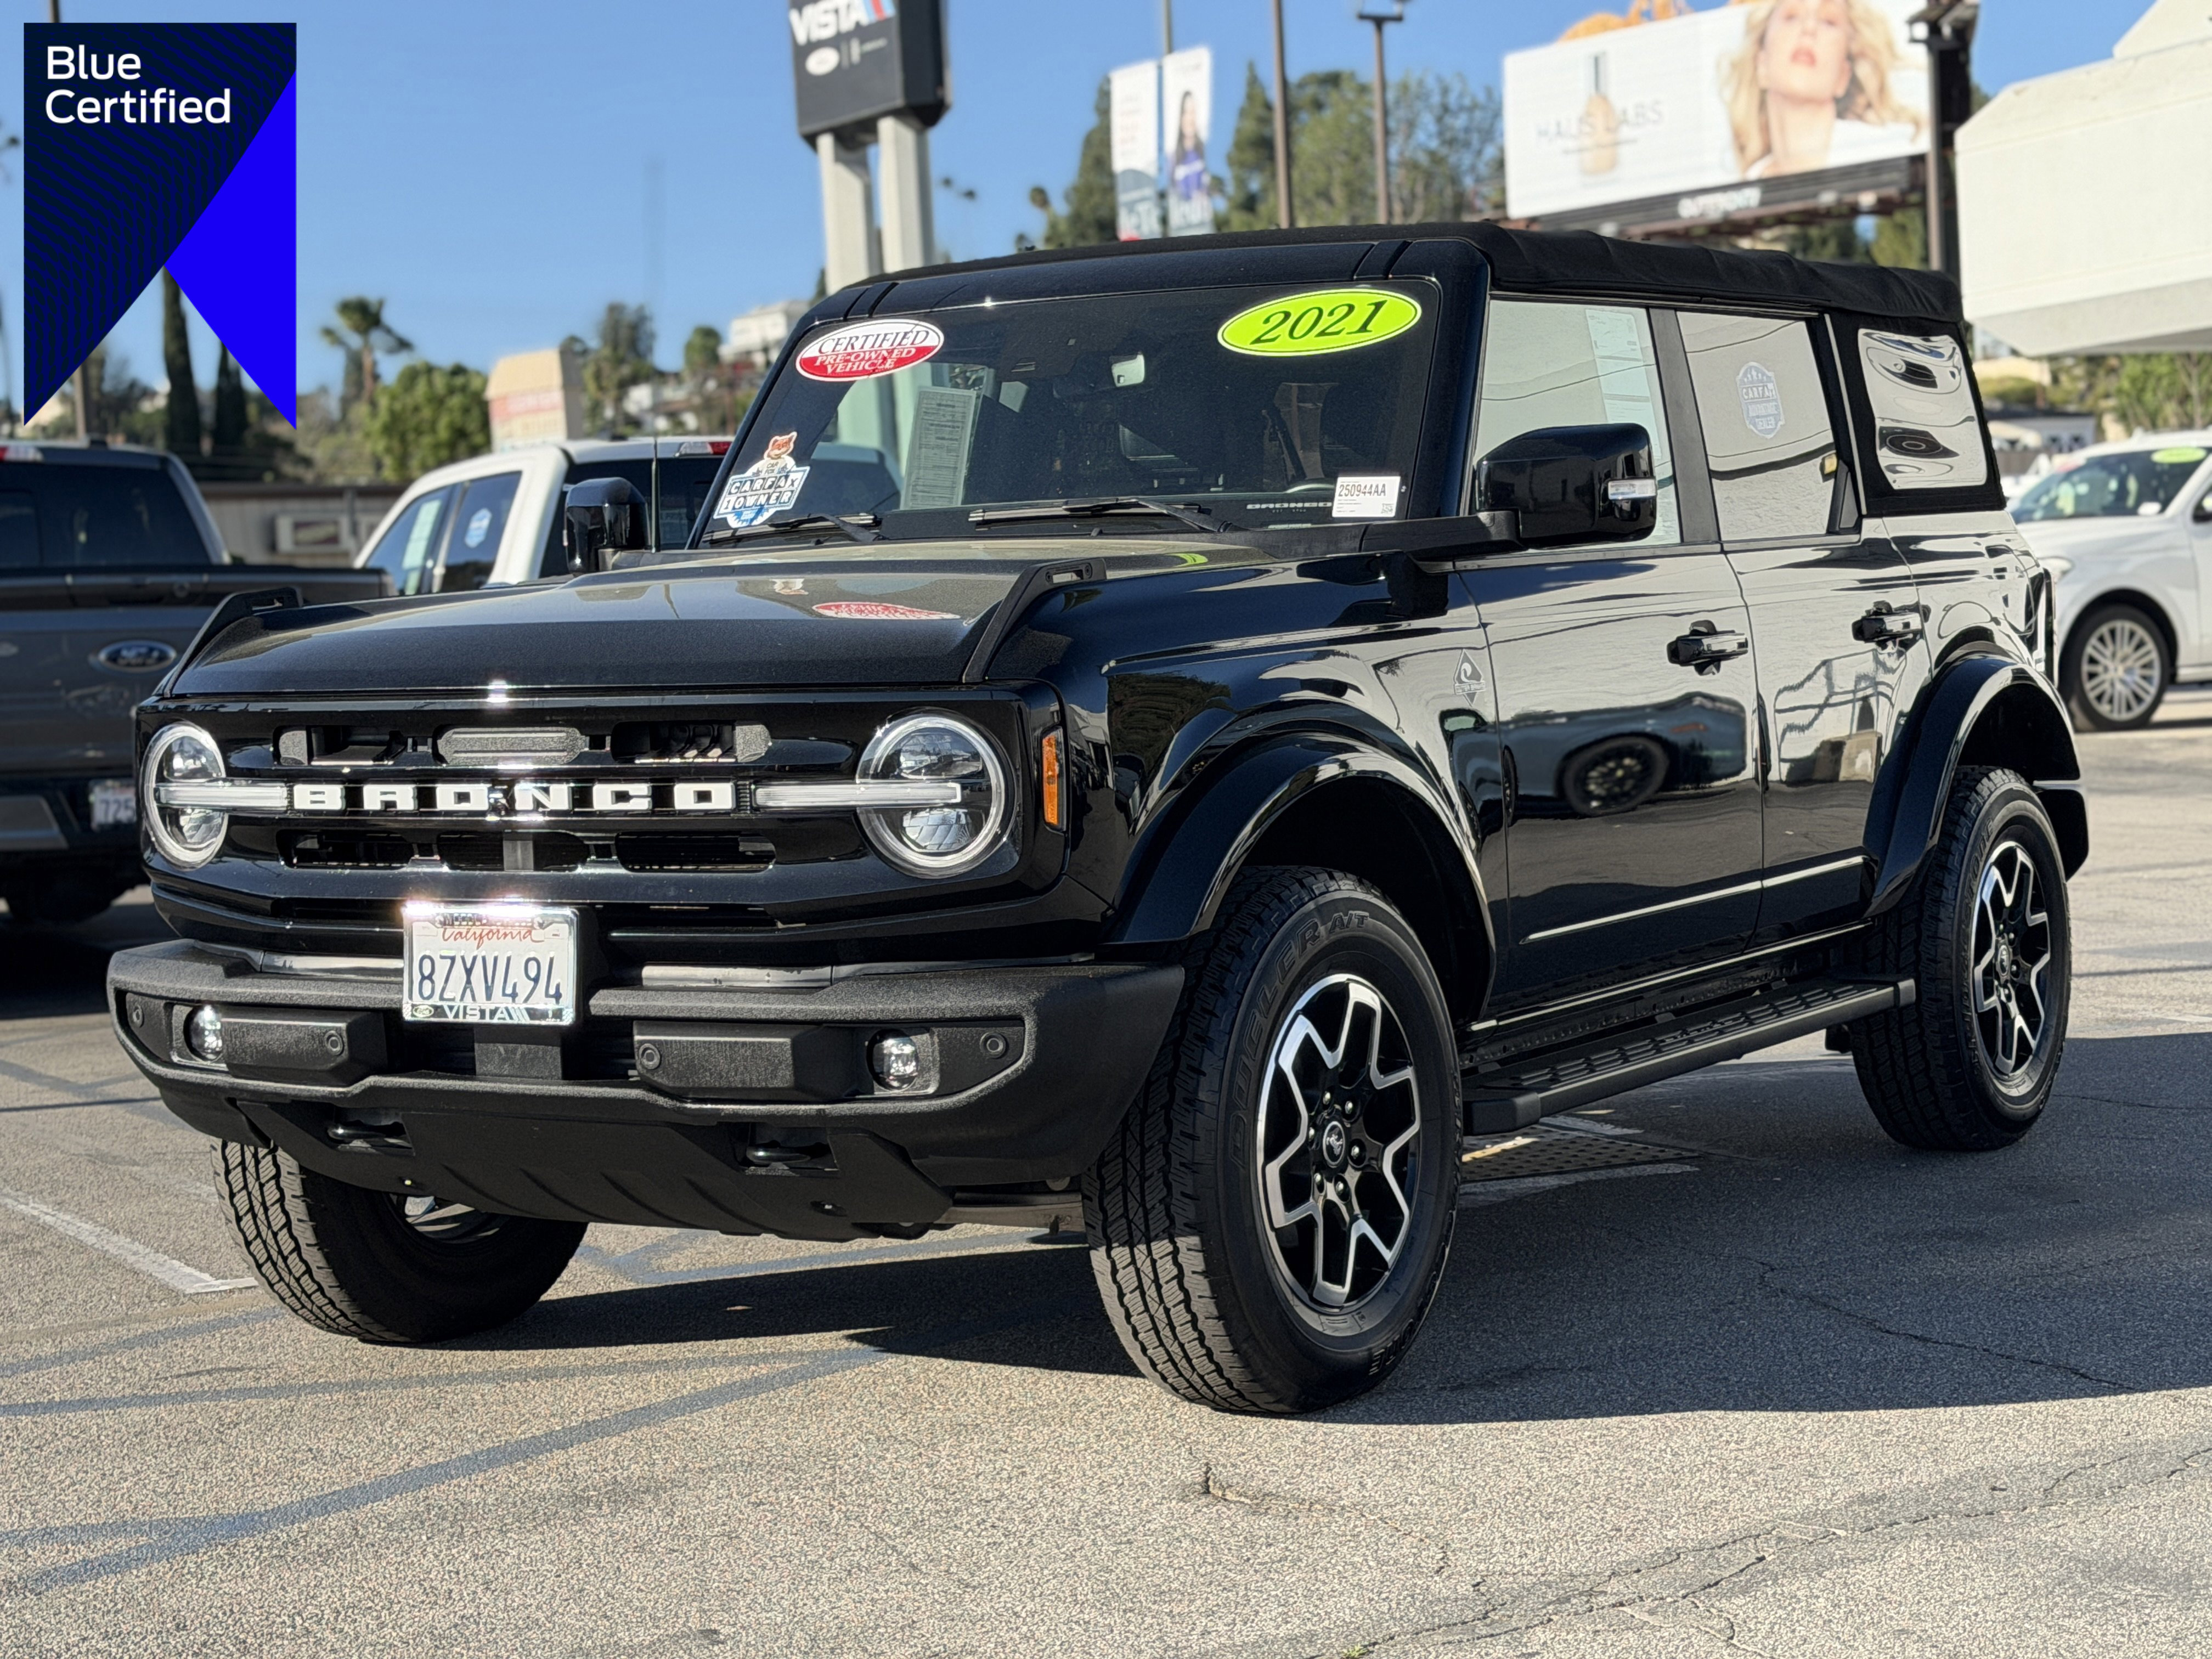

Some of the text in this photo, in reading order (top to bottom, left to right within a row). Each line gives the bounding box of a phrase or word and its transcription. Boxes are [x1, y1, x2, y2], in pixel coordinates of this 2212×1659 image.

[789, 0, 869, 46] VISTA
[1249, 300, 1388, 346] 2021
[818, 330, 930, 355] CERTIFIED
[814, 347, 916, 366] PRE-OWNED
[825, 358, 898, 375] VEHICLE
[730, 476, 799, 494] CARFAX
[1338, 483, 1386, 497] 250944AA
[294, 783, 736, 811] BRONCO
[442, 927, 544, 950] California
[418, 950, 563, 1005] 8ZXV494
[443, 1005, 511, 1022] VISTA
